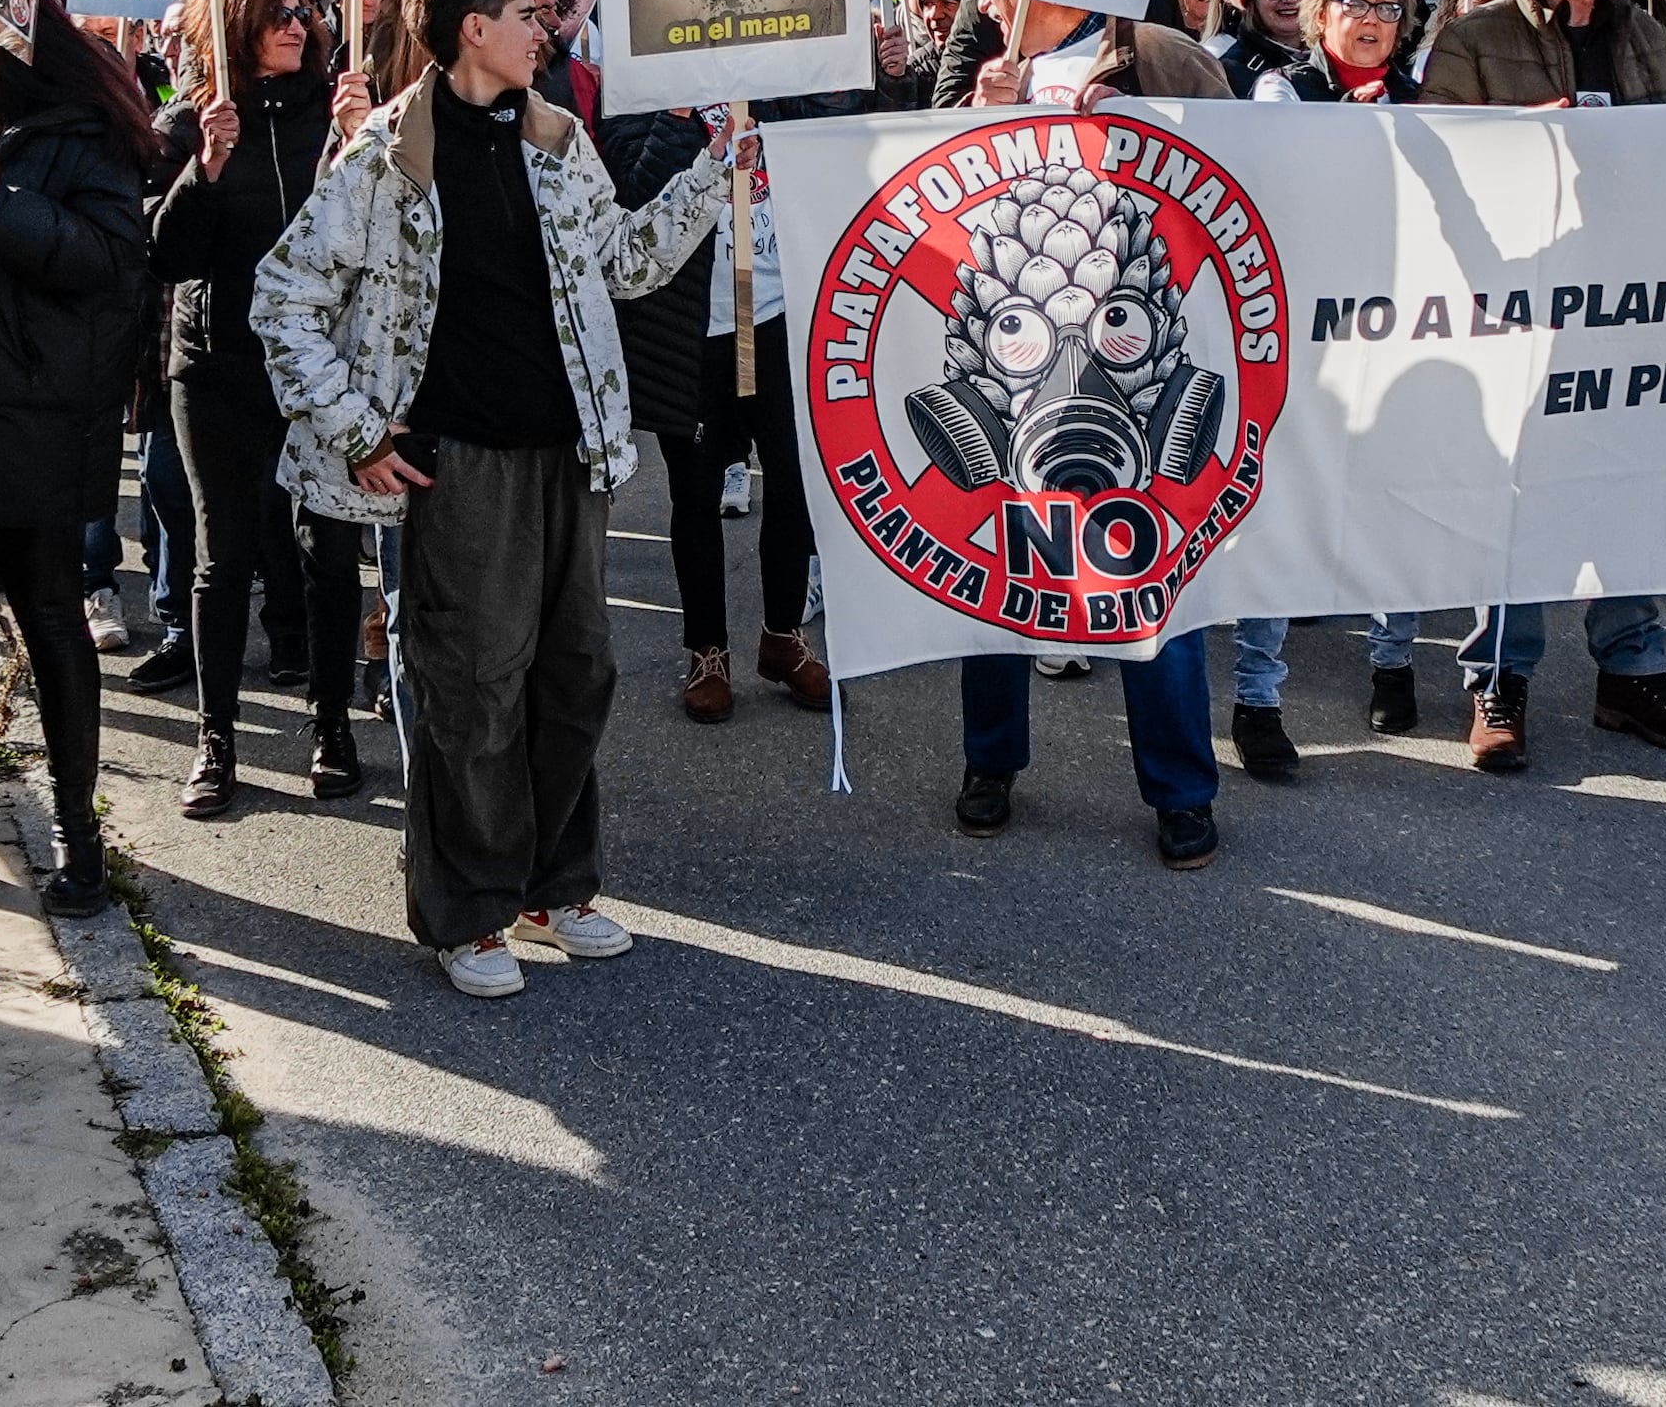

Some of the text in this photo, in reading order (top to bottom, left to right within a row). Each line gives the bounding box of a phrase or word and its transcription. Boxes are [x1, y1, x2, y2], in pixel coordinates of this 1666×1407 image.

[668, 13, 811, 44] en el mapa
[826, 123, 1281, 403] PLATAFORMA PINAREJOS
[1309, 294, 1399, 343] NO
[1410, 295, 1453, 341] A
[1470, 288, 1533, 338] LA
[1543, 367, 1613, 416] EN
[836, 419, 1263, 634] PLANTA DE BIOMETANO
[1001, 496, 1163, 581] NO
